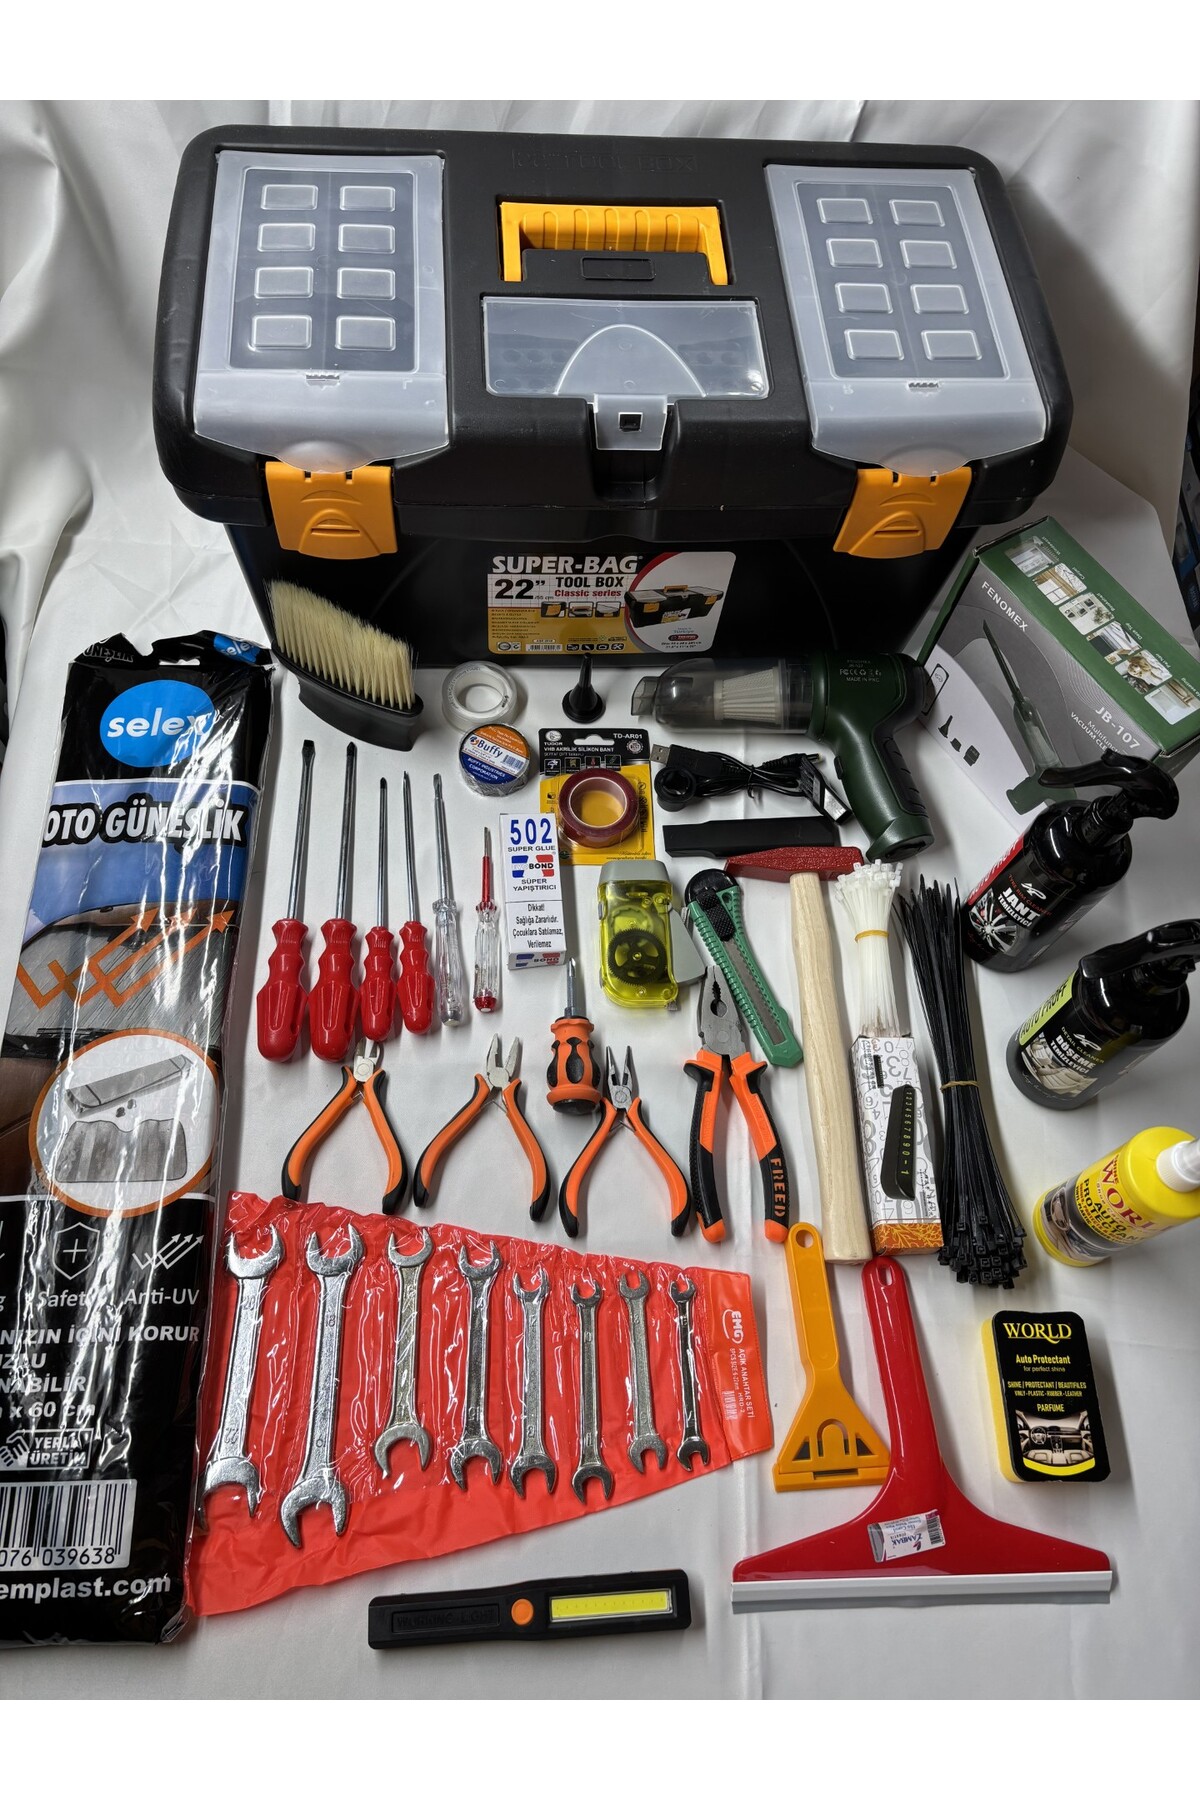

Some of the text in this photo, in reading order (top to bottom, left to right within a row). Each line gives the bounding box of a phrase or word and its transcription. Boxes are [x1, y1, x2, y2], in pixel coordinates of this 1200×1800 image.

[492, 555, 638, 574] SUPER-BAG
[555, 576, 591, 588] TOOL
[595, 576, 624, 588] BOX
[554, 589, 590, 598] Classic
[592, 589, 622, 598] series
[981, 581, 1029, 633] FENOMEX
[1071, 712, 1096, 740] VACUUM
[1095, 707, 1141, 749] JB-107
[477, 739, 504, 759] Buffy
[43, 807, 96, 842] OTO
[510, 817, 553, 845] 502
[513, 884, 557, 892] YAPIŞTIRICI
[527, 903, 545, 912] Dikkat!
[998, 893, 1033, 927] TEMİZLEYİCİ
[1002, 887, 1041, 921] JANT
[516, 915, 535, 926] Sağlığa
[512, 928, 537, 939] Çocuklara
[527, 940, 552, 948] Verilemez
[1050, 1040, 1090, 1074] TEMİZLEYİCİ
[1055, 1034, 1096, 1069] DÖŞEME
[1076, 1046, 1105, 1064] CLEANER
[1102, 1159, 1174, 1231] WORL
[1083, 1178, 1144, 1240] PROTECTAN
[1094, 1202, 1127, 1232] AUTO
[37, 1289, 199, 1312] Safet Anti-UV
[127, 1326, 200, 1343] KORUR
[731, 1310, 744, 1342] EMG
[1003, 1322, 1072, 1344] WORLD
[1016, 1354, 1071, 1364] Auto Protectant
[738, 1347, 754, 1417] AÇIK ANAHTAR SETİ
[1025, 1381, 1055, 1389] PROTECTANT
[28, 1401, 56, 1418] 60
[1037, 1403, 1065, 1412] PARFUME
[30, 1450, 86, 1466] ÜRETİM
[42, 1548, 115, 1567] 039638
[0, 1576, 171, 1605] emplast.com
